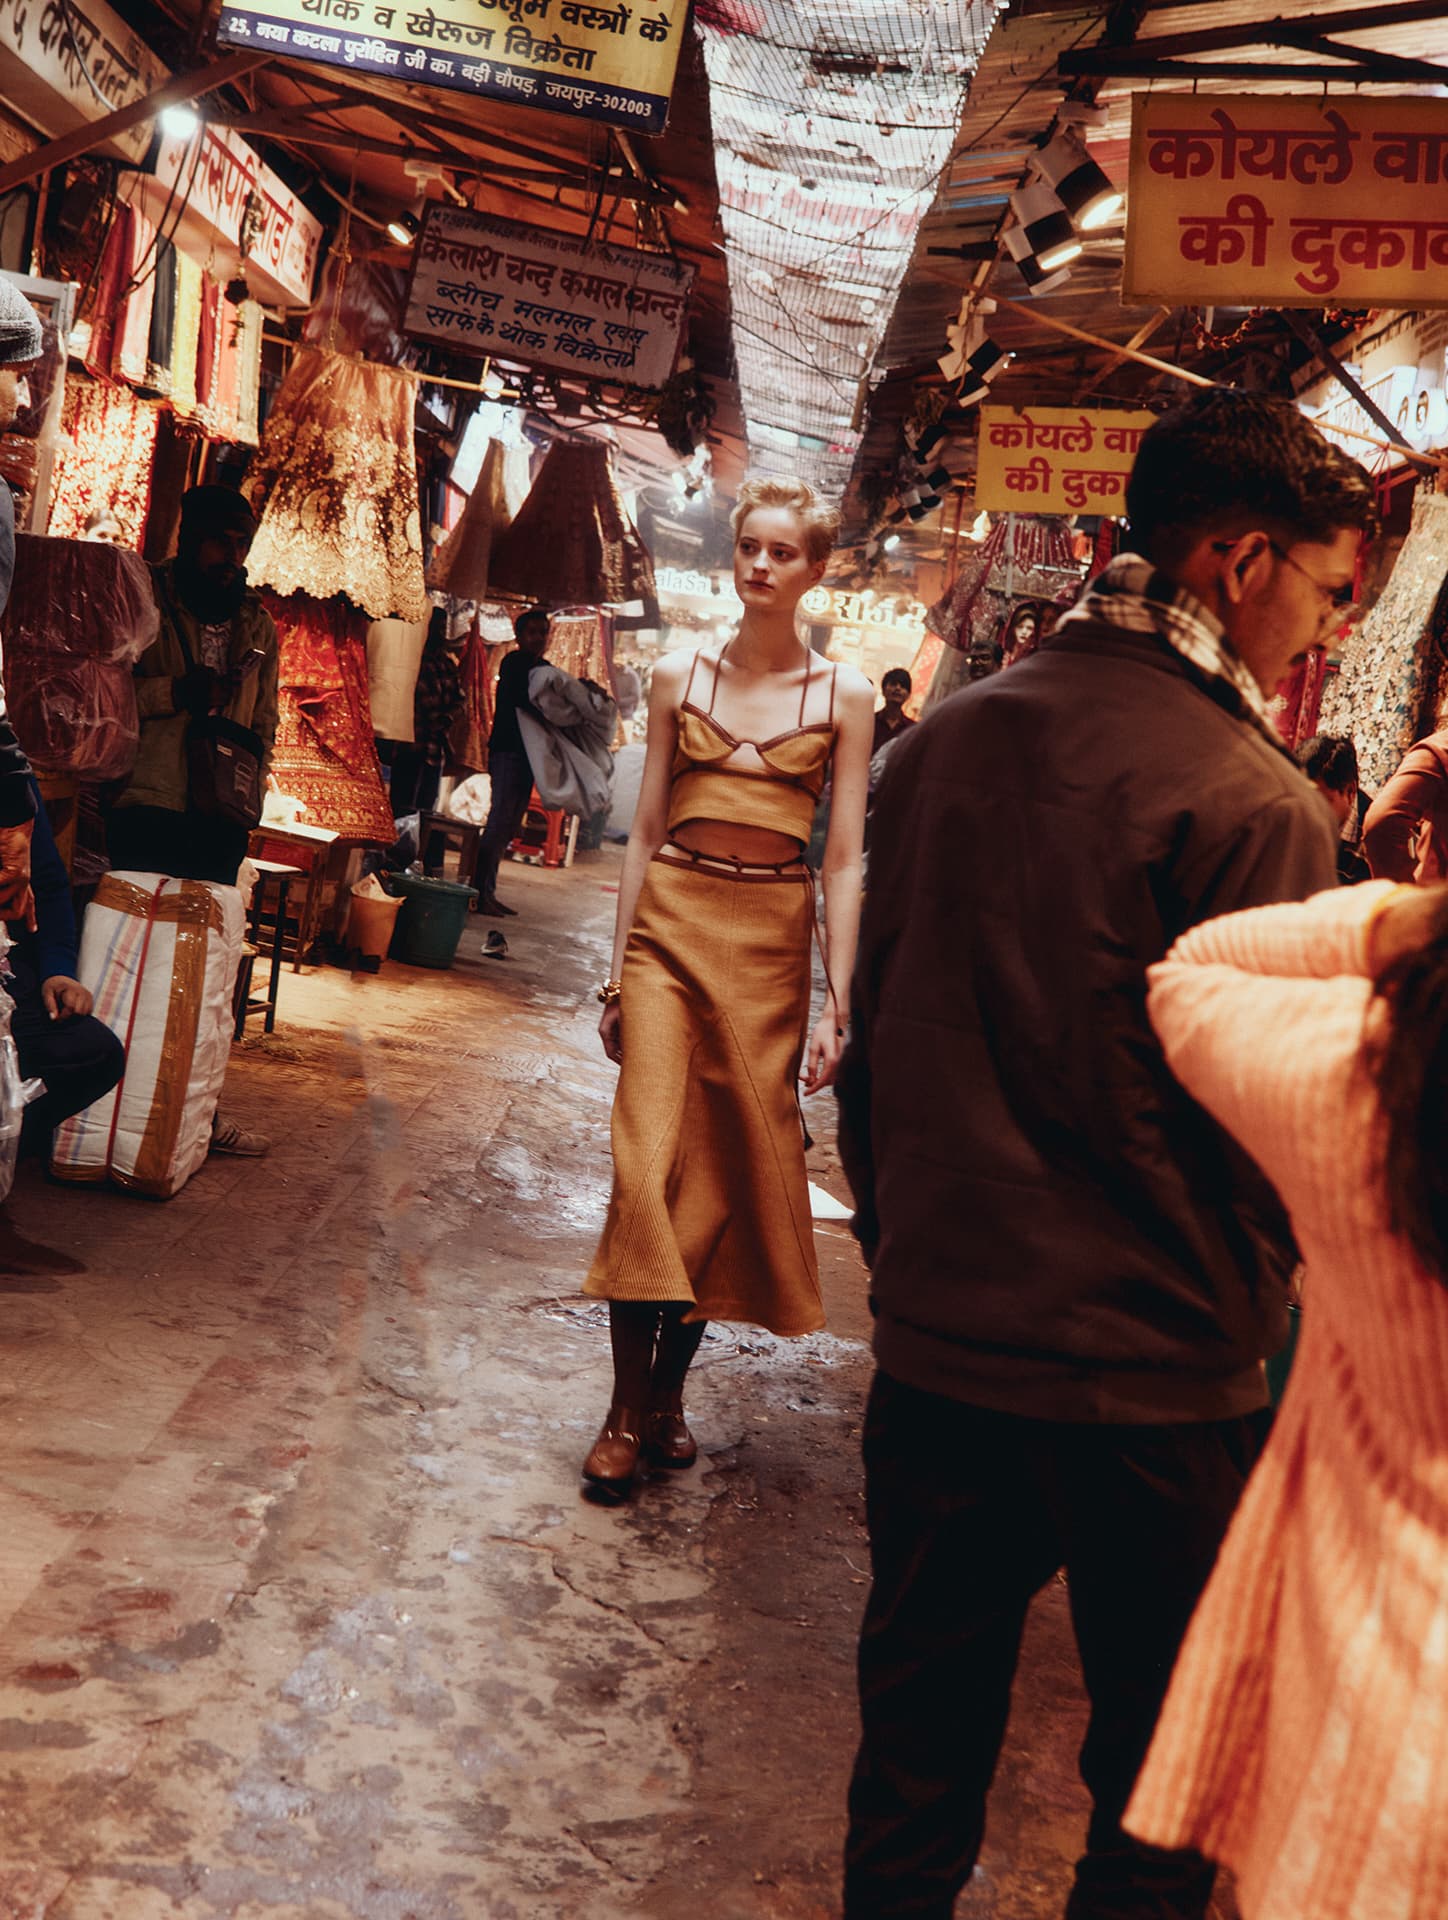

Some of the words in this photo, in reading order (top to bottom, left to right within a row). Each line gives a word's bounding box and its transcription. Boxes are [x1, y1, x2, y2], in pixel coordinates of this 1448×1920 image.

[374, 6, 397, 29] व
[406, 8, 496, 50] खेरूज
[504, 25, 597, 71] विक्रेता
[561, 1, 632, 35] वस्त्रों
[639, 12, 672, 42] के
[228, 17, 251, 36] 25,
[256, 22, 290, 42] नया
[291, 29, 342, 53] कटला
[344, 38, 401, 63] पुरोहित
[404, 48, 427, 70] जी
[430, 57, 456, 77] का,
[461, 62, 491, 87] बड़ी
[495, 67, 539, 97] चौपड़,
[1147, 108, 1361, 184] कोयले
[1373, 132, 1448, 184] वा
[1178, 194, 1274, 266] की
[506, 254, 558, 297] चन्द
[560, 268, 628, 310] कमल
[499, 321, 548, 349] थोक
[514, 299, 596, 335] मलमल
[988, 414, 1097, 452] कोयले
[1104, 427, 1146, 453] वा
[1005, 456, 1053, 493] की
[1062, 468, 1132, 508] दुका
